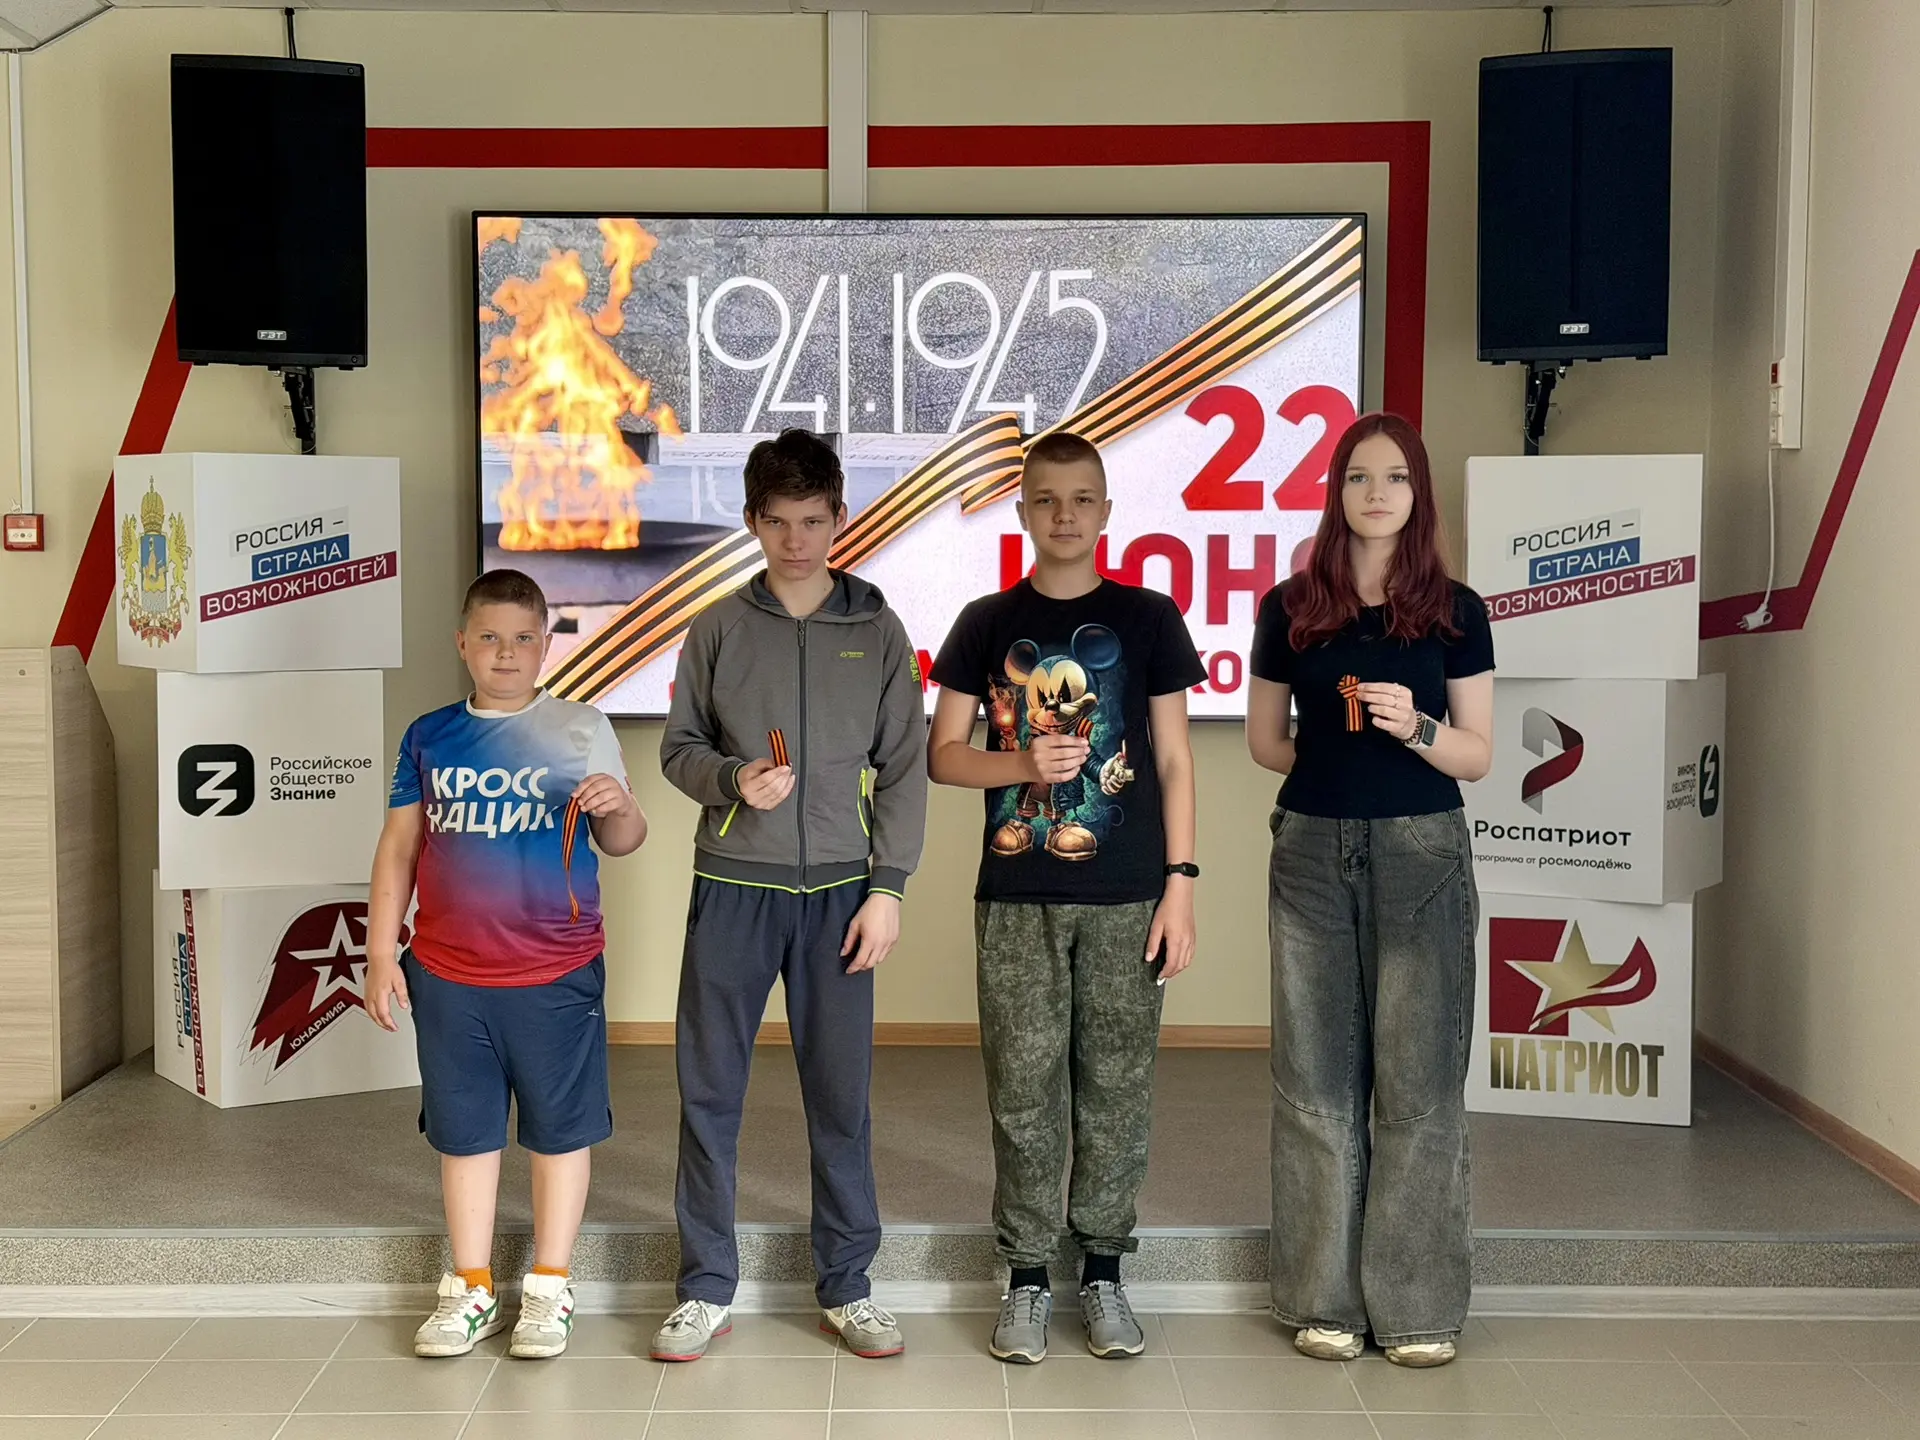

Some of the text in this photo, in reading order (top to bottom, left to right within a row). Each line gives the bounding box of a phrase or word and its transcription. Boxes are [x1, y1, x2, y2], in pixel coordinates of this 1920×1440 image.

[1181, 385, 1357, 510] 22
[235, 517, 323, 552] РОССИЯ
[1513, 519, 1611, 555] РОССИЯ
[258, 542, 342, 577] СТРАНА
[1536, 545, 1632, 580] СТРАНА
[206, 555, 388, 617] ВОЗМОЖНОСТЕЙ
[270, 756, 373, 771] Российское
[270, 773, 355, 787] общество
[270, 787, 336, 801] Знание
[431, 767, 549, 799] КРОСС
[1474, 820, 1632, 847] Роспатриот
[1474, 853, 1632, 870] программа от росмолодёжь
[172, 957, 185, 1048] РОССИЯ
[180, 942, 192, 1030] СТРАНА
[183, 897, 206, 1089] ВОЗМОЖНОСТЕЙ
[289, 1000, 347, 1050] ЮНАРМИЯ
[1490, 1037, 1665, 1098] ПАТРИОТ
